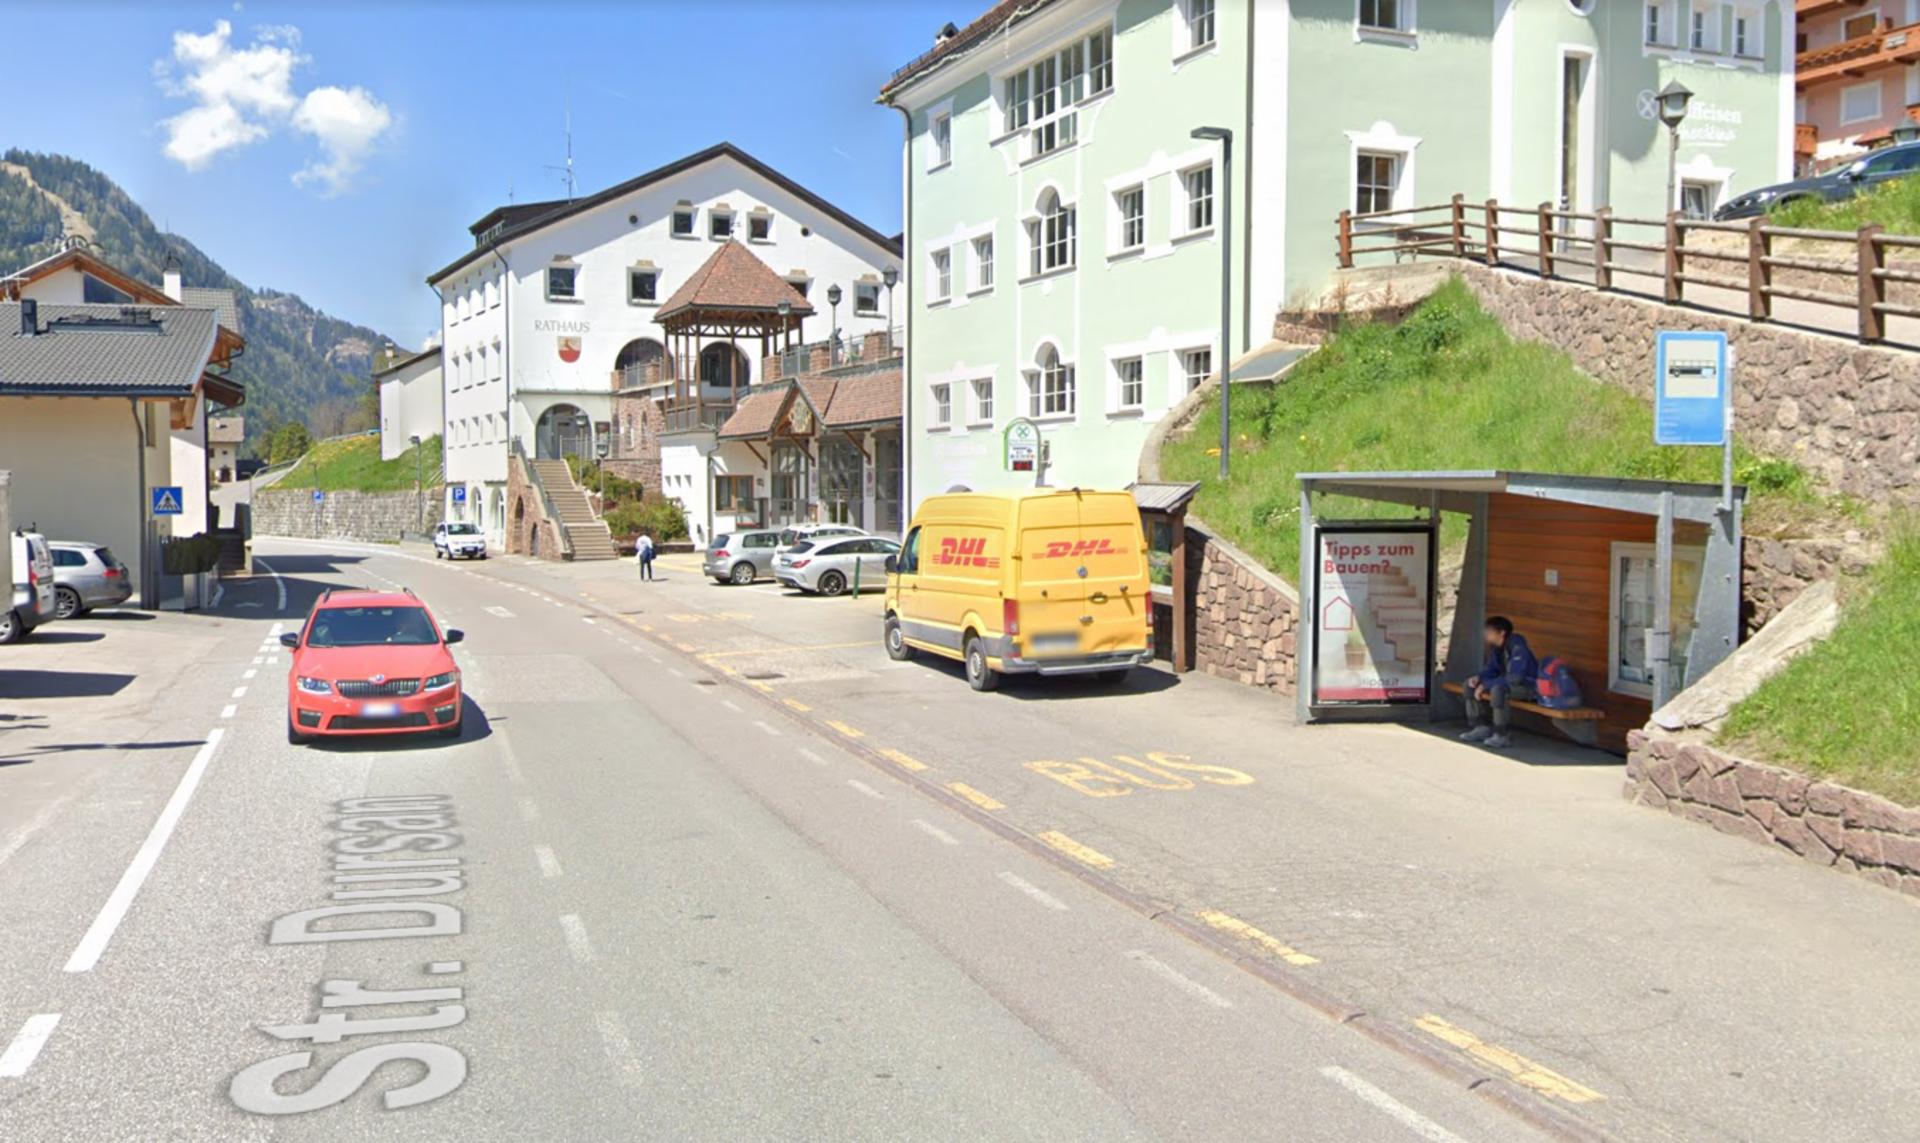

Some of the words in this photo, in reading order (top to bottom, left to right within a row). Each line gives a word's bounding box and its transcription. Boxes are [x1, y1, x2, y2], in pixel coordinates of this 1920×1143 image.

[534, 319, 591, 334] RATHAUS
[455, 488, 464, 501] P
[939, 537, 988, 567] DHL
[1045, 539, 1115, 559] DHL
[1324, 541, 1371, 559] Tipps
[1377, 544, 1415, 556] zum
[1324, 559, 1391, 574] Bauen?
[1022, 752, 1255, 797] BUS
